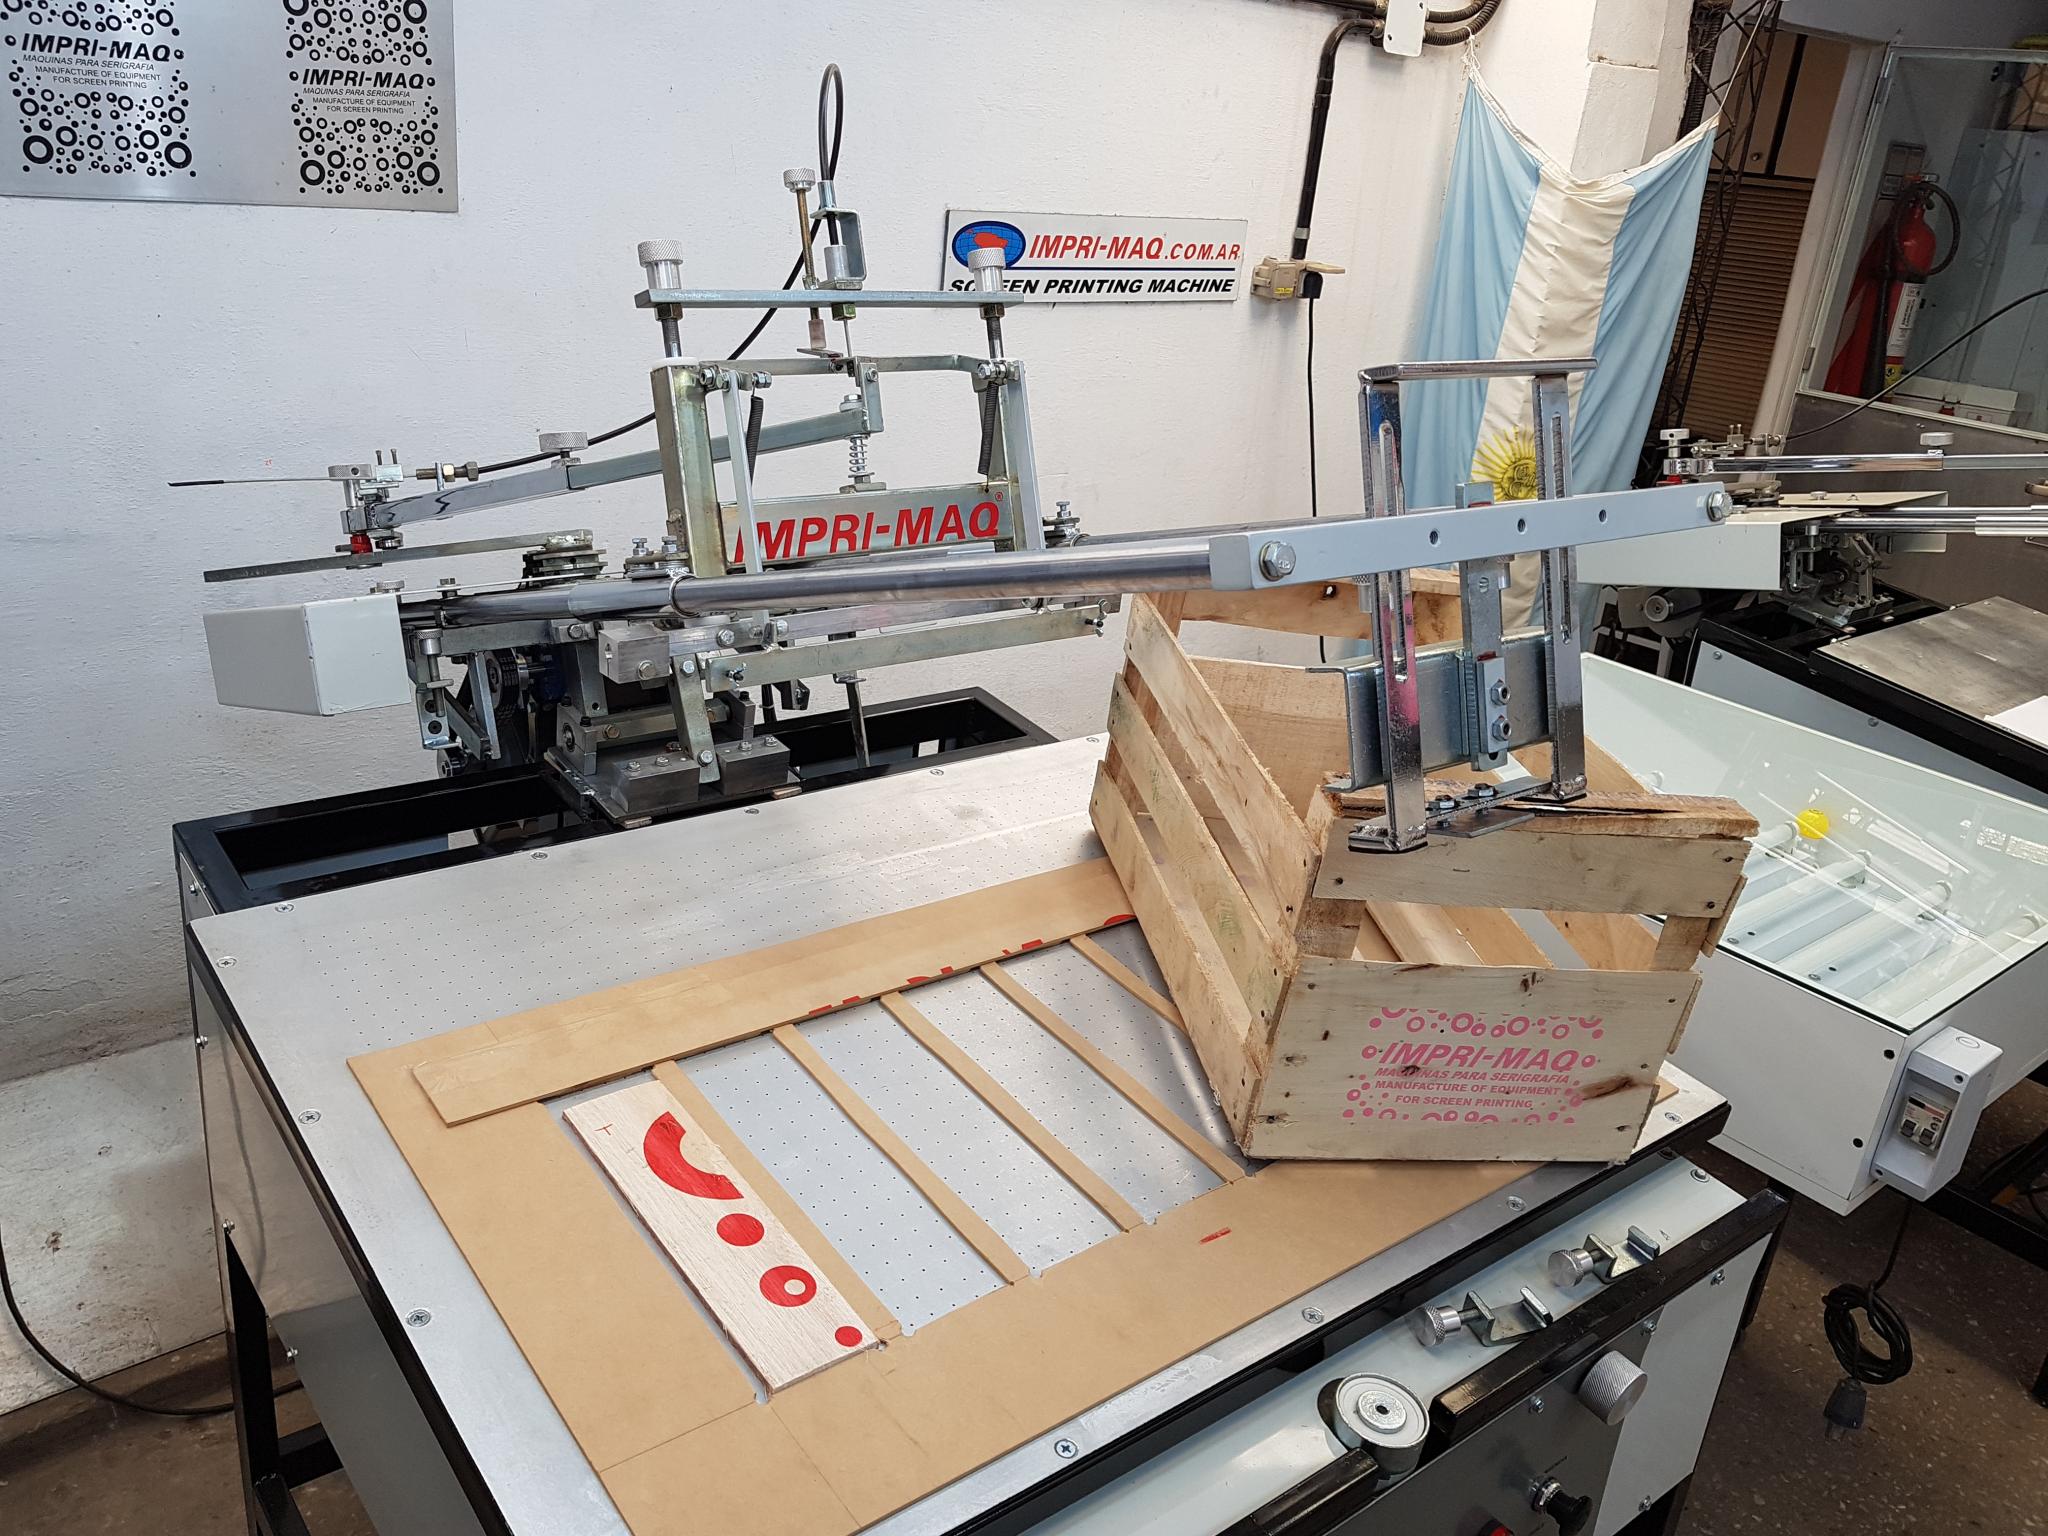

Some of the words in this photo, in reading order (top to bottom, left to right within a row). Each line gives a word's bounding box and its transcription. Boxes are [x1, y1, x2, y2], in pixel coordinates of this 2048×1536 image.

[21, 33, 171, 62] IMPRI-MAQ
[23, 54, 73, 65] MAQUINAS
[75, 58, 100, 68] PARA
[101, 60, 155, 71] SERIGRAFIA
[35, 66, 100, 77] MANUFACTURE
[101, 70, 112, 78] OF
[114, 71, 161, 81] EQUIPMENT
[302, 69, 424, 89] IMPRI-MAQ
[53, 76, 72, 84] FOR
[73, 77, 107, 86] SCREEN
[109, 79, 147, 89] PRINTING
[303, 87, 344, 96] MAQUINAS
[366, 90, 410, 98] SERIGRAFIA
[312, 97, 364, 106] MANUFACTURE
[377, 99, 416, 107] EQUIPMENT
[343, 106, 371, 114] SCREEN
[949, 279, 1040, 294] SCEN
[1044, 279, 1144, 294] PRINTING
[1147, 278, 1235, 293] MACHINE
[1378, 1042, 1579, 1072] IMPRI-MAQ
[1451, 1070, 1488, 1081] PARA
[1490, 1072, 1569, 1085] SERIGRAFIA
[1375, 1080, 1469, 1093] MANUFACTURE
[1471, 1084, 1487, 1093] OF
[1491, 1085, 1561, 1096] EQUIPMENT
[1395, 1095, 1420, 1105] FOR
[1422, 1096, 1472, 1107] SCREEN
[1475, 1098, 1532, 1109] PRINTING
